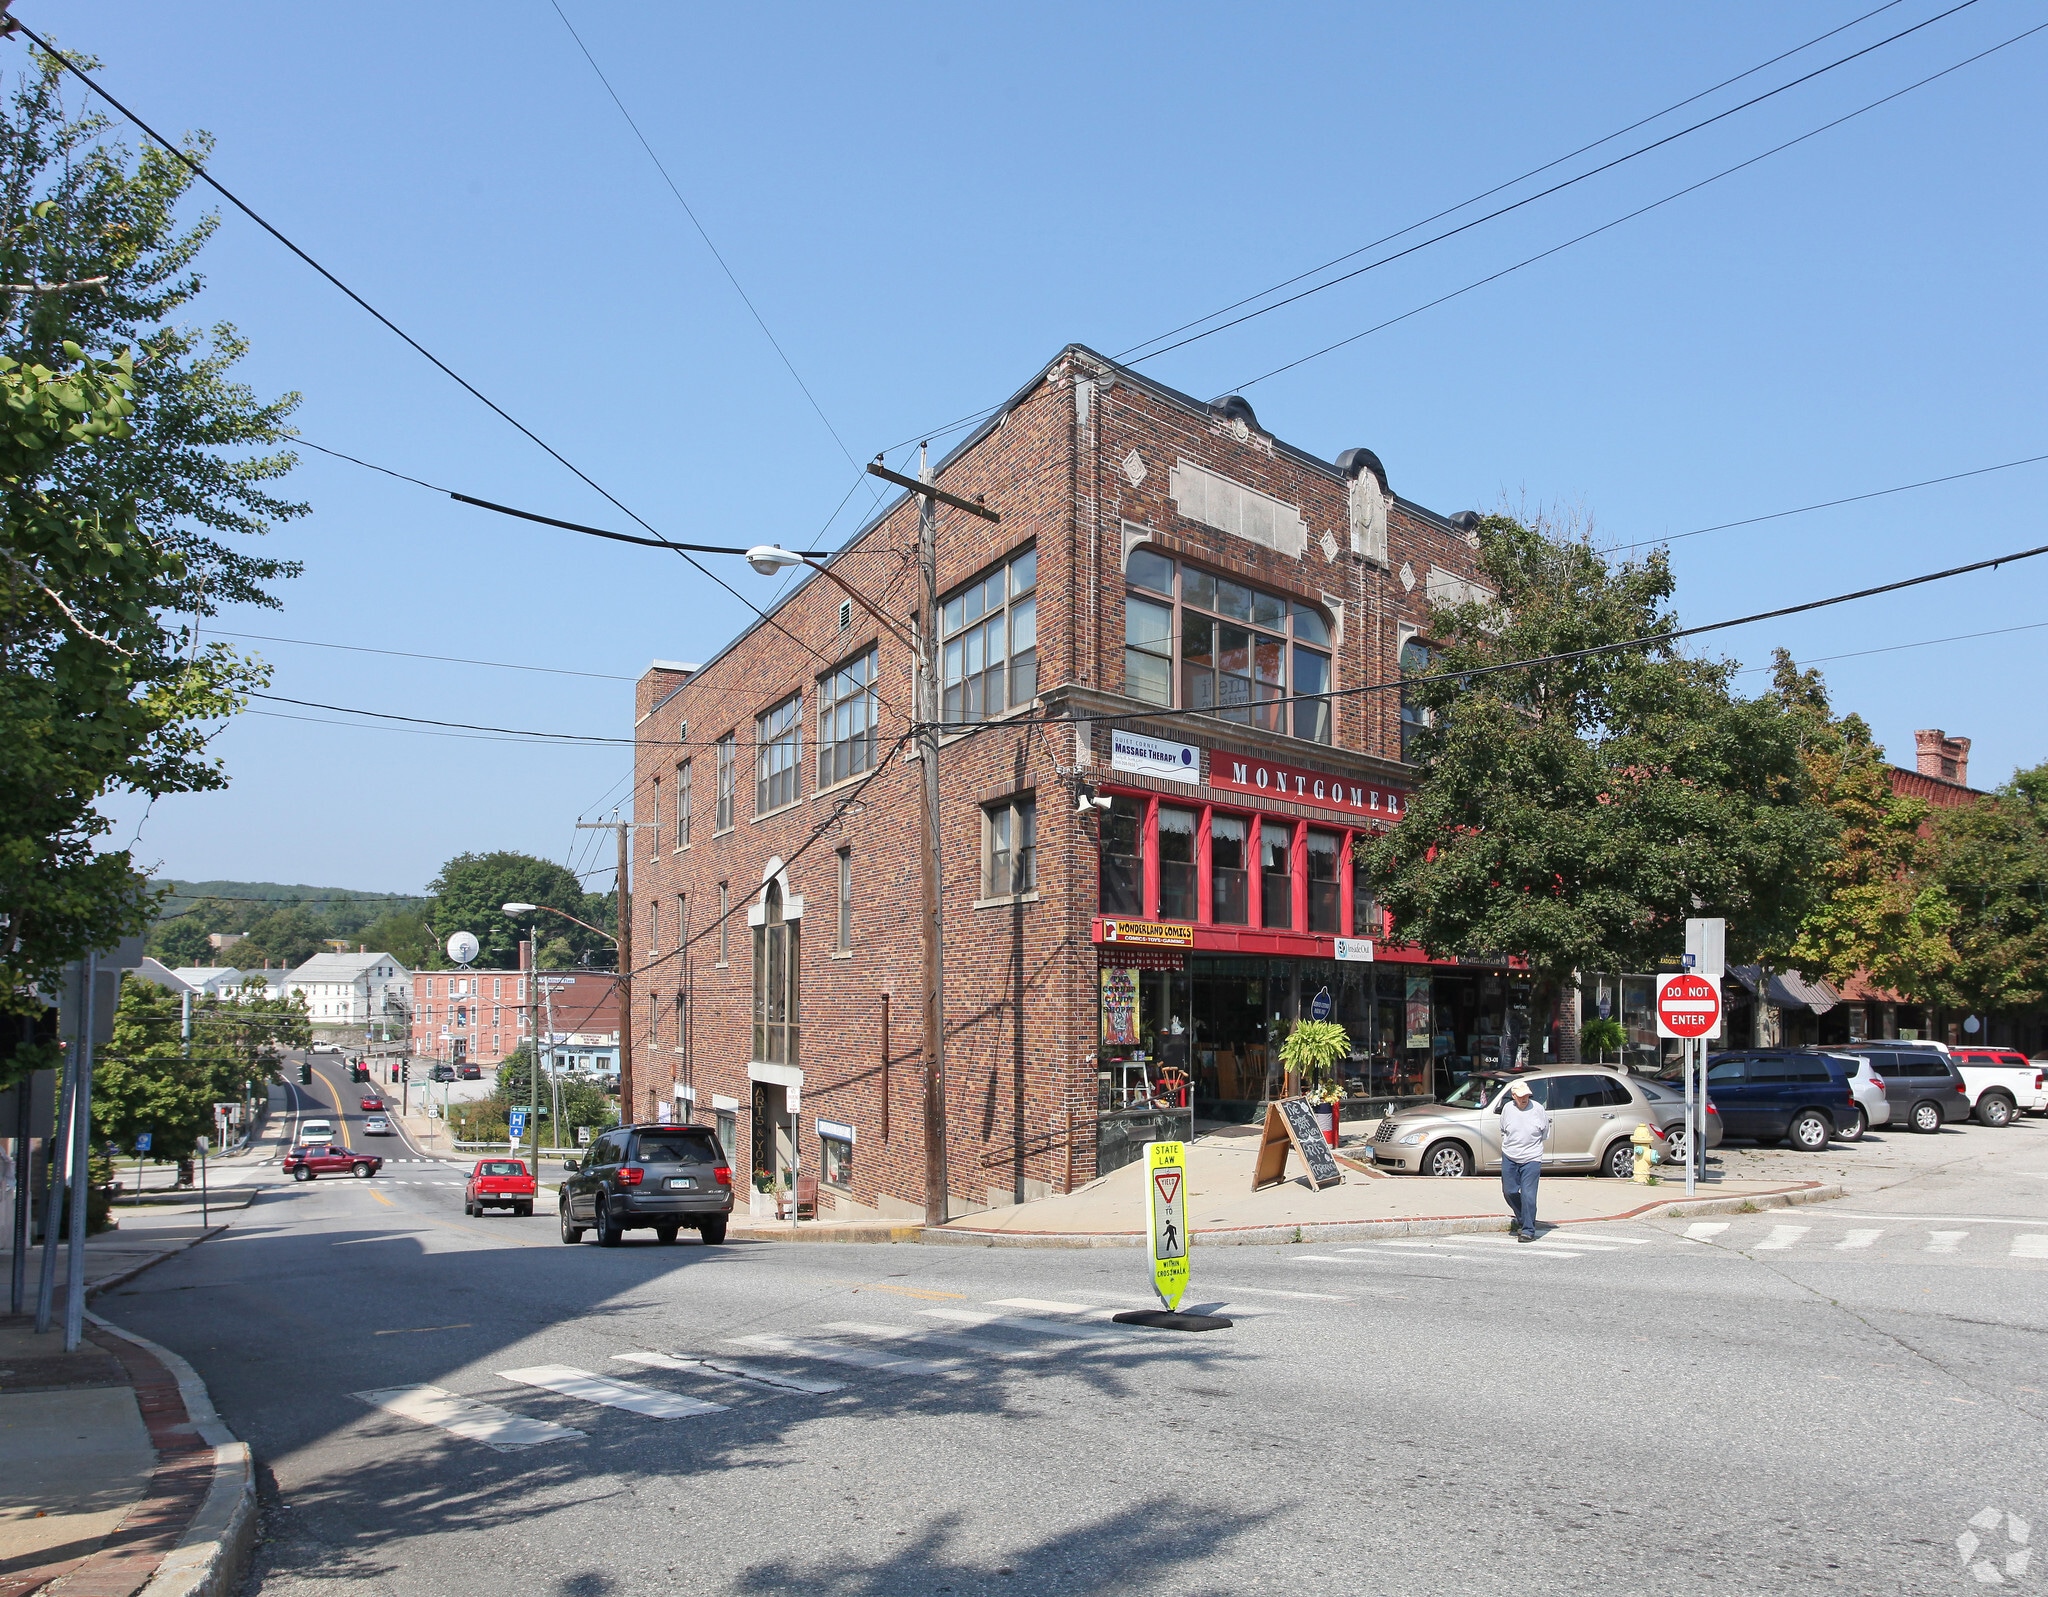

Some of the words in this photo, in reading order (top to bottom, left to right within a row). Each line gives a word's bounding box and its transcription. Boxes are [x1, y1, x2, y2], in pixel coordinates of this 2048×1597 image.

[1202, 679, 1248, 697] iem
[1115, 736, 1133, 745] QUIET
[1135, 740, 1158, 749] CORNER
[1115, 742, 1147, 758] MASSAGE
[1148, 749, 1177, 764] THERAPY
[1118, 922, 1163, 936] WONDERLAND
[1164, 926, 1191, 938] COMICS
[1102, 985, 1136, 993] CORNER
[1667, 987, 1682, 997] DO
[1688, 987, 1710, 997] NOT
[1671, 1014, 1706, 1025] ENTER
[512, 1114, 523, 1126] H
[755, 1139, 765, 1169] YOG
[1155, 1145, 1179, 1155] STATE
[1159, 1156, 1175, 1165] LAW
[1161, 1178, 1175, 1186] YIELD
[1162, 1260, 1180, 1268] WITHIN
[1157, 1268, 1187, 1278] CROSSWALK
